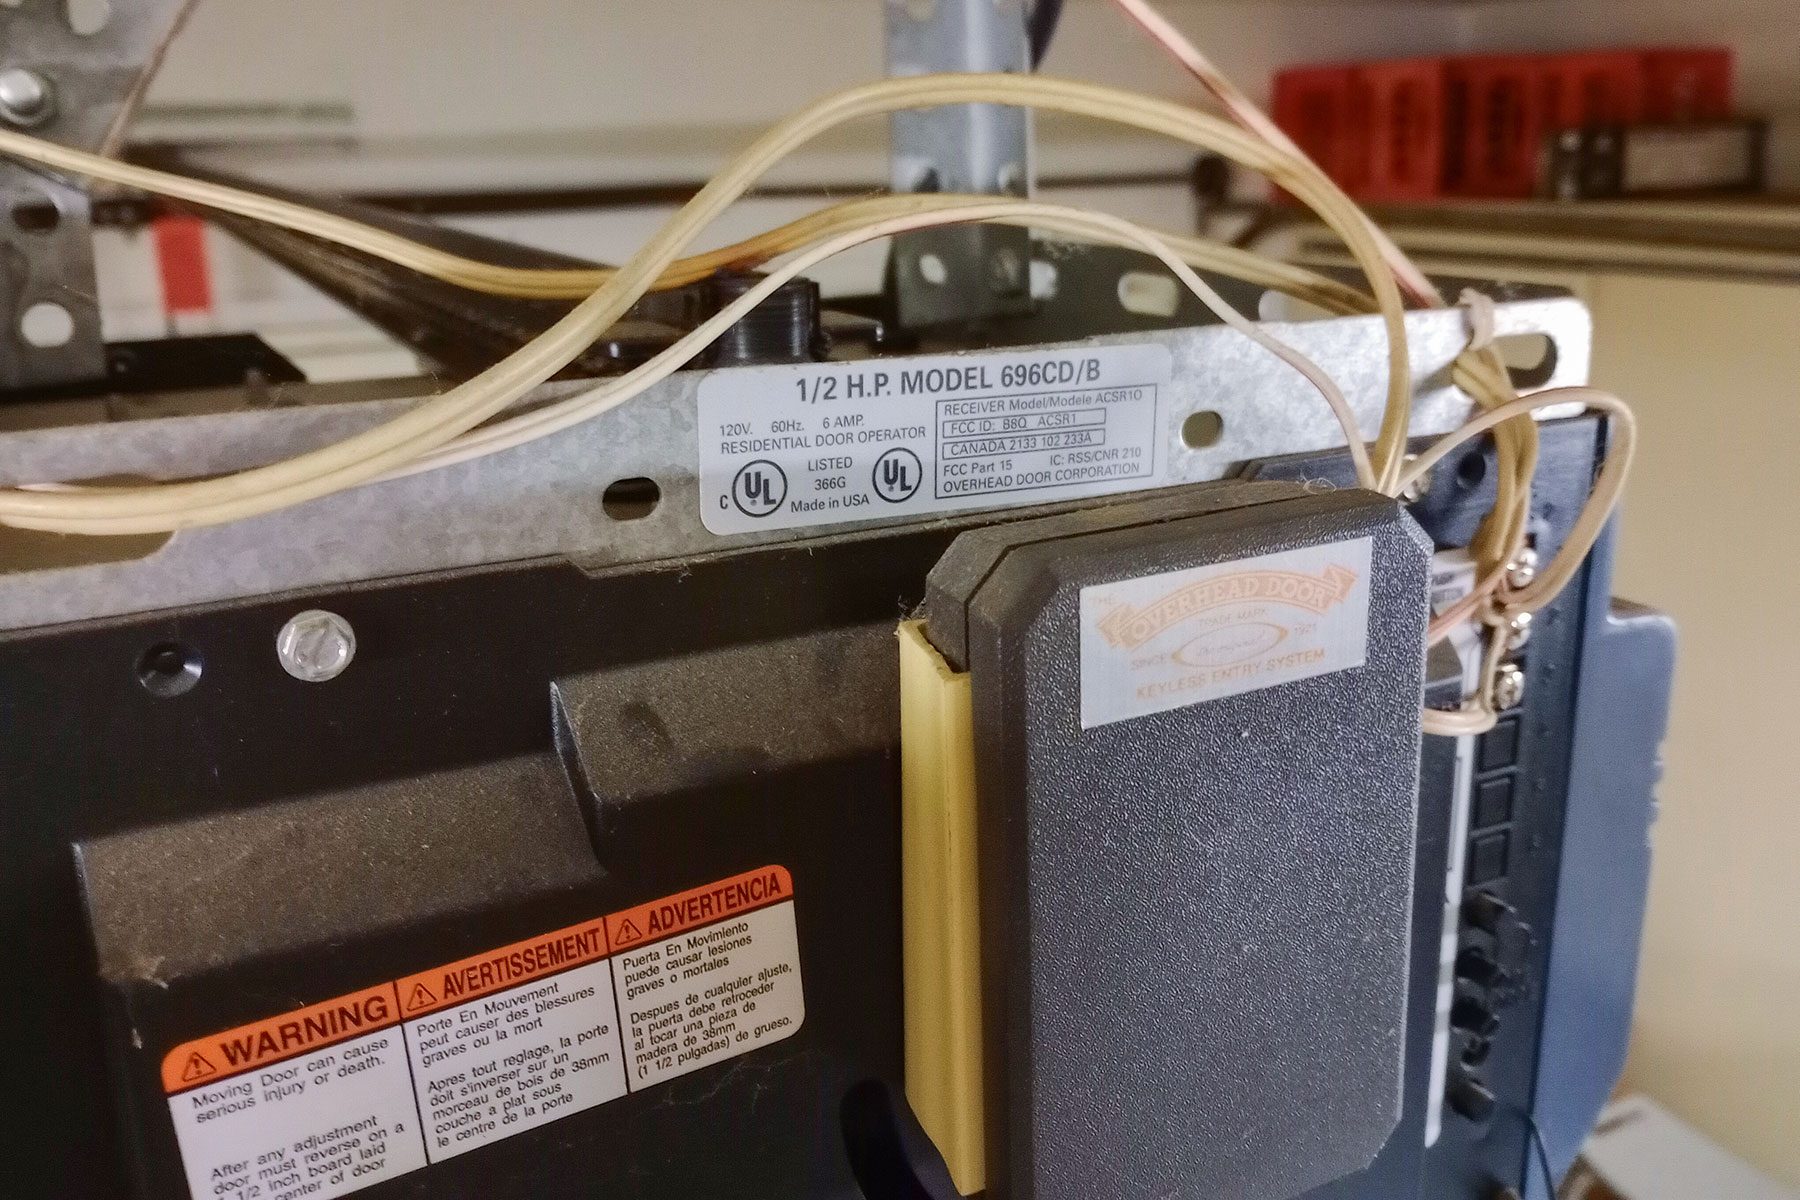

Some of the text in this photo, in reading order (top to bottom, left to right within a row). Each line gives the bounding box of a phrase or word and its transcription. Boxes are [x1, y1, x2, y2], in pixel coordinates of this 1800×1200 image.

[796, 358, 1100, 404] 1/2 H.P. MODEL 696CD/B
[944, 399, 1005, 416] RECEIVER
[1009, 391, 1092, 411] Model/Modele
[720, 414, 865, 437] 120V. 60Hz. 6 AMP.
[720, 426, 927, 455] RESIDENTIAL DOOR OPERATOR
[951, 421, 976, 434] FCC
[979, 419, 996, 433] ID:
[1037, 413, 1077, 427] ACSR1
[951, 431, 1092, 456] CANADA 2133 102 233A
[808, 456, 853, 472] LISTED
[883, 458, 913, 492] UL
[943, 459, 1013, 477] FCC Part 15
[943, 461, 1140, 494] OVERHEAD DOOR CORPORATION
[1050, 446, 1142, 466] IC: RSS/CNR 210
[744, 471, 776, 506] UL
[791, 493, 870, 513] Made in USA
[814, 476, 846, 491] 366G
[1130, 576, 1328, 640] OVERHEAD DOOR
[1136, 648, 1326, 699] KEYLESS ENTRY SYSTEM
[648, 872, 782, 935] ADVERTENCIA
[443, 927, 601, 1000] AVERTISSEMENT
[622, 921, 749, 971] Puerta En Movimiento
[624, 935, 753, 987] puede causar lesiones
[626, 955, 730, 1001] graves o mortales
[630, 962, 792, 1025] Despues de cualquier ajuste,
[220, 994, 389, 1067] WARNING
[416, 982, 560, 1038] Porte En Mouvement
[420, 985, 596, 1054] peut causer des blessures
[632, 980, 775, 1038] la puerta debe retroceder
[634, 1000, 756, 1052] al tocar una pieza de
[422, 1016, 544, 1069] graves ou la mort
[427, 1023, 610, 1094] Apres tout reglage, la porte
[636, 1022, 736, 1065] madera de 38mm
[656, 1055, 673, 1071] 1/2
[678, 1034, 731, 1066] pulgadas)
[735, 1027, 749, 1044] de
[754, 1016, 793, 1038] grueso.
[191, 1038, 389, 1109] Moving Door can cause
[196, 1055, 386, 1124] serious injury or death.
[429, 1052, 570, 1107] doit s'inverser sur un
[433, 1052, 610, 1121] morceau de bois de 38mm
[435, 1083, 562, 1135] couche a plat sous
[437, 1091, 574, 1148] le centre de la porte
[210, 1114, 379, 1181] After any adjustment
[213, 1122, 405, 1196] door must reverse on a
[268, 1172, 301, 1193] inch
[308, 1153, 352, 1177] board
[360, 1141, 386, 1161] laid
[275, 1157, 388, 1200] center of door
